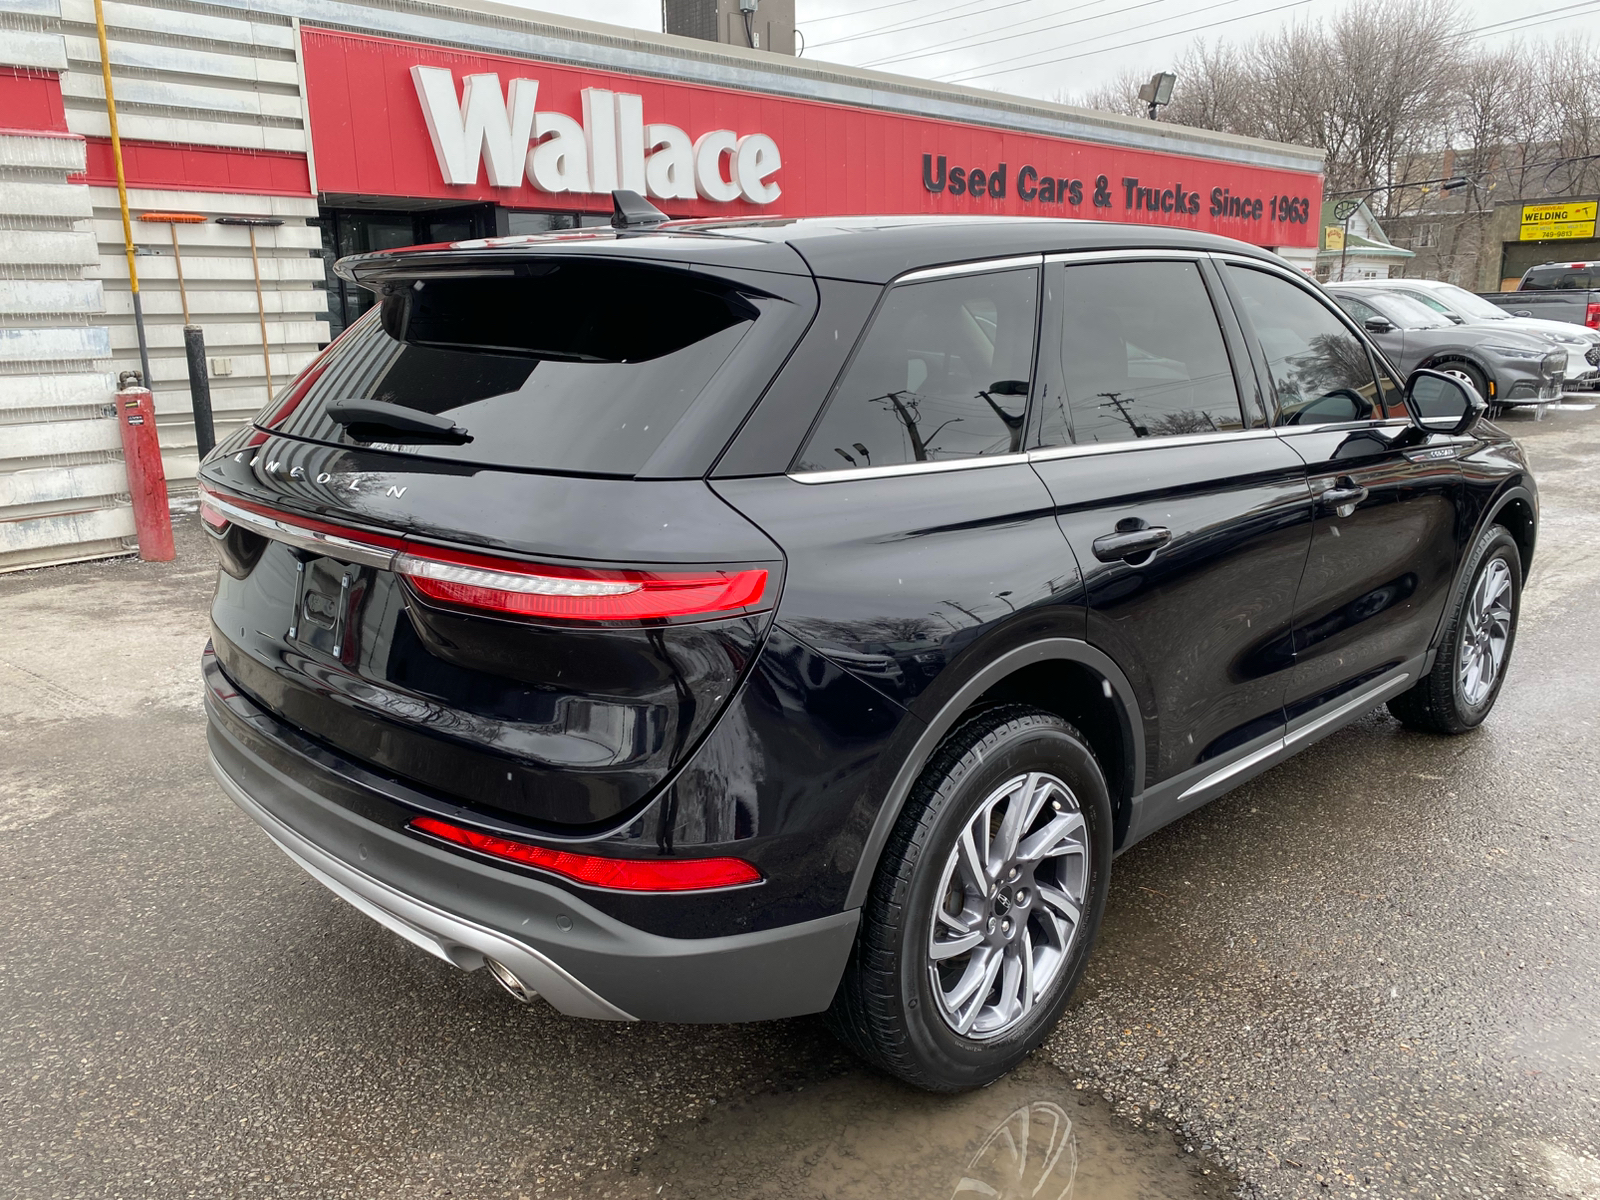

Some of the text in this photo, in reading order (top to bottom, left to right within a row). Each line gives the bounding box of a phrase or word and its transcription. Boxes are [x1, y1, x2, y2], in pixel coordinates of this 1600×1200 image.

[409, 65, 782, 205] Wallace
[922, 153, 1309, 224] Used Cars & Trucks Since 1963
[1525, 211, 1568, 221] WELDING
[1542, 230, 1573, 238] 749-9813
[233, 452, 407, 499] LINCOLN
